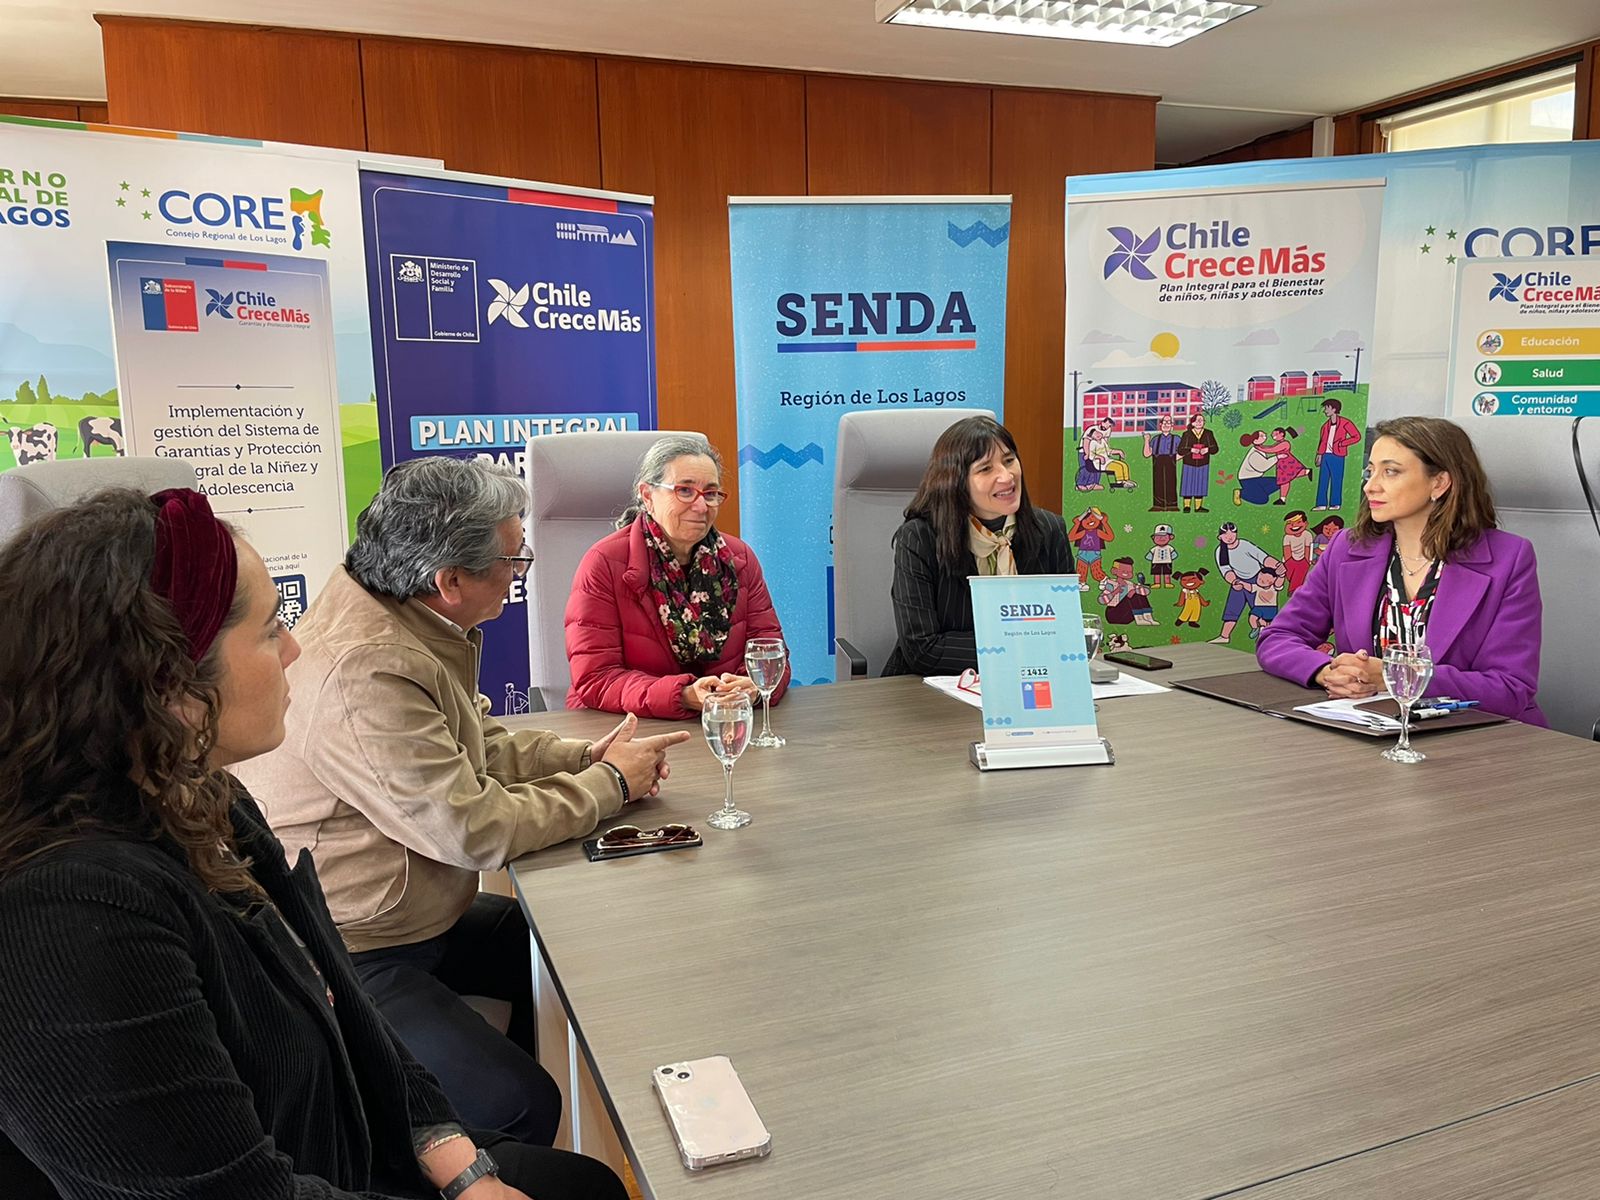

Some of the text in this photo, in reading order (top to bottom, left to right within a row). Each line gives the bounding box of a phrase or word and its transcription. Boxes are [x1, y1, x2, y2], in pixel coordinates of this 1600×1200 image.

[36, 189, 69, 206] DE
[158, 189, 287, 231] CORE
[166, 228, 288, 245] Consejo Regional de Los Lagos
[1166, 220, 1250, 250] Chile
[430, 262, 470, 272] Ministerio de
[430, 270, 462, 279] Desarrollo
[1159, 277, 1325, 293] Plan Integral para el Bienestar
[1525, 271, 1572, 287] Chile
[431, 285, 454, 293] Familia
[532, 282, 591, 307] Chile
[1159, 287, 1324, 302] de niños, niñas y adolescentes
[236, 291, 276, 306] Chile
[776, 291, 976, 337] SENDA
[1520, 336, 1581, 347] Educación
[1532, 368, 1564, 379] Salud
[780, 389, 967, 409] Región de Los Lagos
[1511, 394, 1578, 406] Comunidad
[169, 404, 305, 421] Implementación y
[1517, 405, 1573, 416] y entorno
[153, 423, 320, 442] gestión del Sistema de
[418, 419, 495, 446] PLAN
[154, 442, 322, 459] Garantías y Protección
[228, 463, 247, 476] de
[251, 462, 264, 475] la
[267, 461, 308, 474] Niñez
[310, 462, 319, 475] y
[198, 480, 295, 497] Adolescencia
[263, 555, 290, 563] acional
[1000, 603, 1056, 618] SENDA
[1027, 668, 1048, 676] 1412
